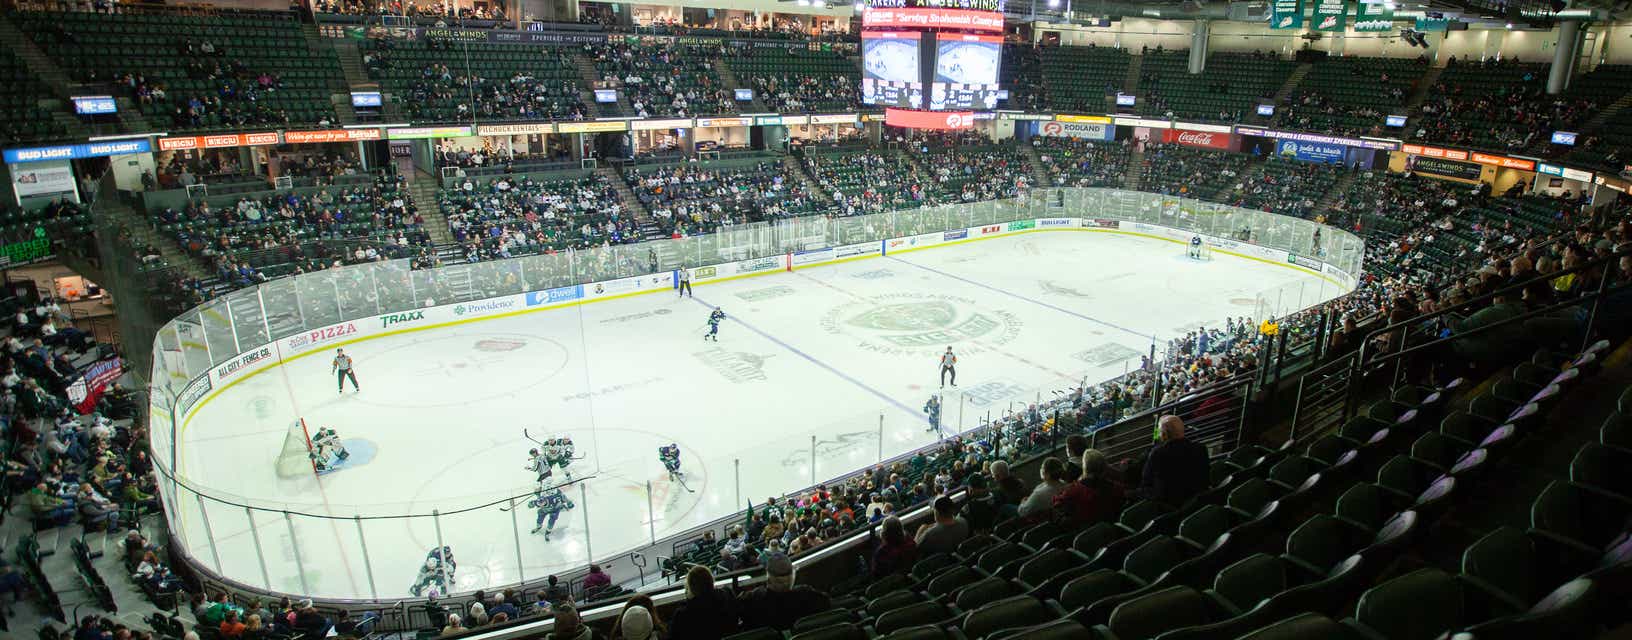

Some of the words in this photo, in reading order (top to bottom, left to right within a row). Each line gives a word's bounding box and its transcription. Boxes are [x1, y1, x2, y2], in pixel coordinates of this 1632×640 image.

[929, 14, 970, 24] Snohomish
[459, 31, 487, 39] WINDS
[478, 125, 512, 133] PILCHUCK
[1064, 123, 1100, 132] RODLAND
[17, 151, 40, 160] BUD
[42, 148, 72, 158] LIGHT
[90, 145, 111, 154] BUD
[112, 143, 139, 151] LIGHT
[1416, 159, 1438, 168] ANGEL
[1442, 162, 1463, 171] WINDS
[468, 300, 513, 313] Providence
[380, 310, 425, 328] TRAXX
[310, 323, 357, 343] PIZZA
[228, 359, 240, 372] CITY
[242, 351, 259, 365] FENCE
